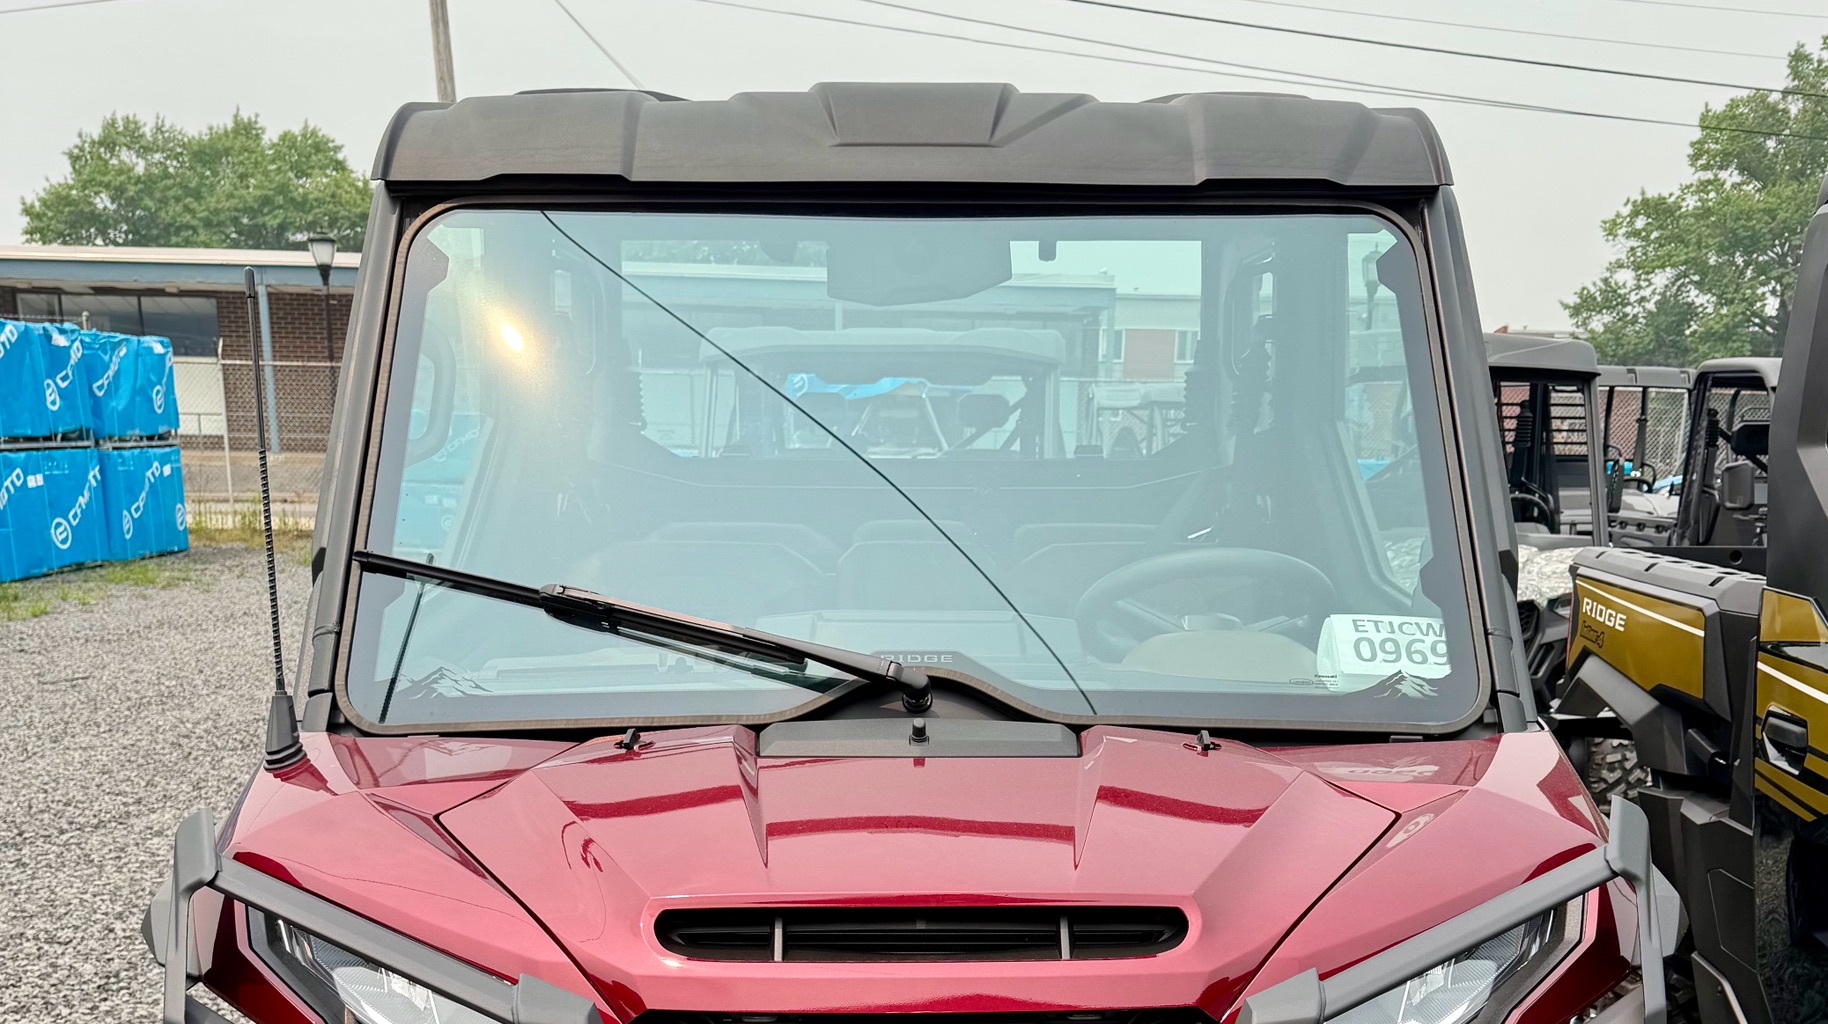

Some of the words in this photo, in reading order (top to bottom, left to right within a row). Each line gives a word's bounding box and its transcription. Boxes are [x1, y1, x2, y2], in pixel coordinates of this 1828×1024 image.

[1582, 597, 1627, 632] RIDGE
[880, 654, 953, 663] RIDGE
[1353, 636, 1449, 666] 0969
